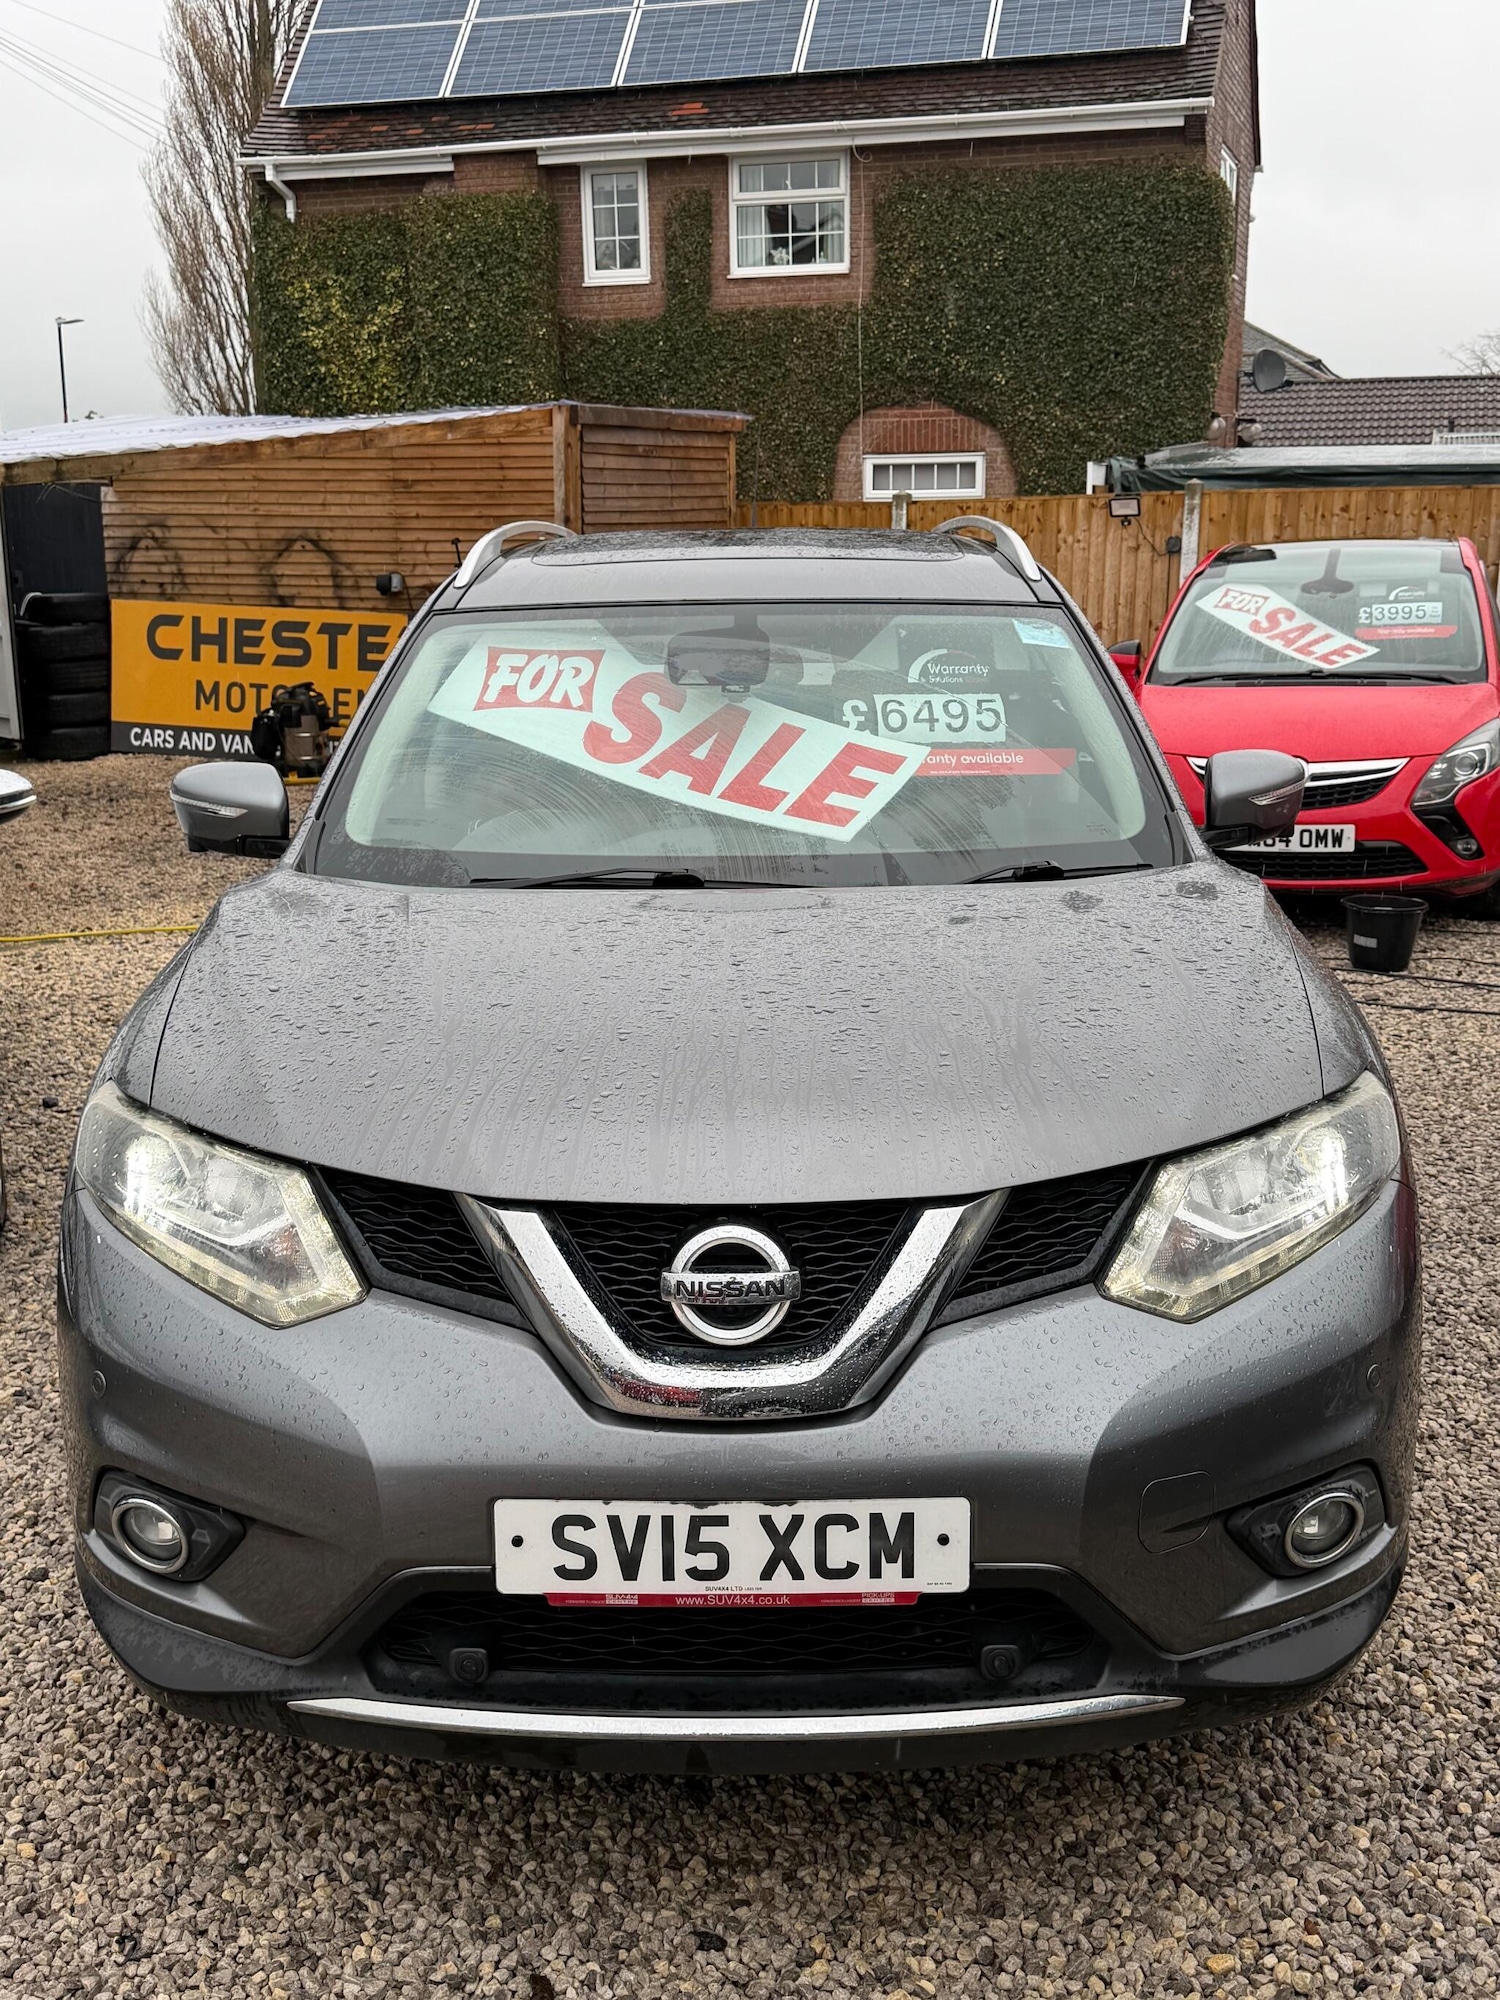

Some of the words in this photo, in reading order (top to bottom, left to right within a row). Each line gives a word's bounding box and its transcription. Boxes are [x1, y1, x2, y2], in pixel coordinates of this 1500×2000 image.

[1218, 590, 1265, 613] FOR
[1249, 607, 1367, 666] SALE
[147, 614, 407, 671] CHESTE
[927, 663, 990, 677] Warranty
[130, 727, 174, 749] CARS
[179, 731, 216, 752] AND
[483, 654, 594, 707] FOR
[582, 672, 908, 828] SALE
[961, 752, 1024, 763] available
[1300, 828, 1344, 848] OMW
[676, 1279, 785, 1297] NISSAN
[551, 1514, 730, 1582] SV15
[758, 1512, 915, 1582] XCM
[675, 1594, 791, 1606] www.SUV4x4.co.uk
